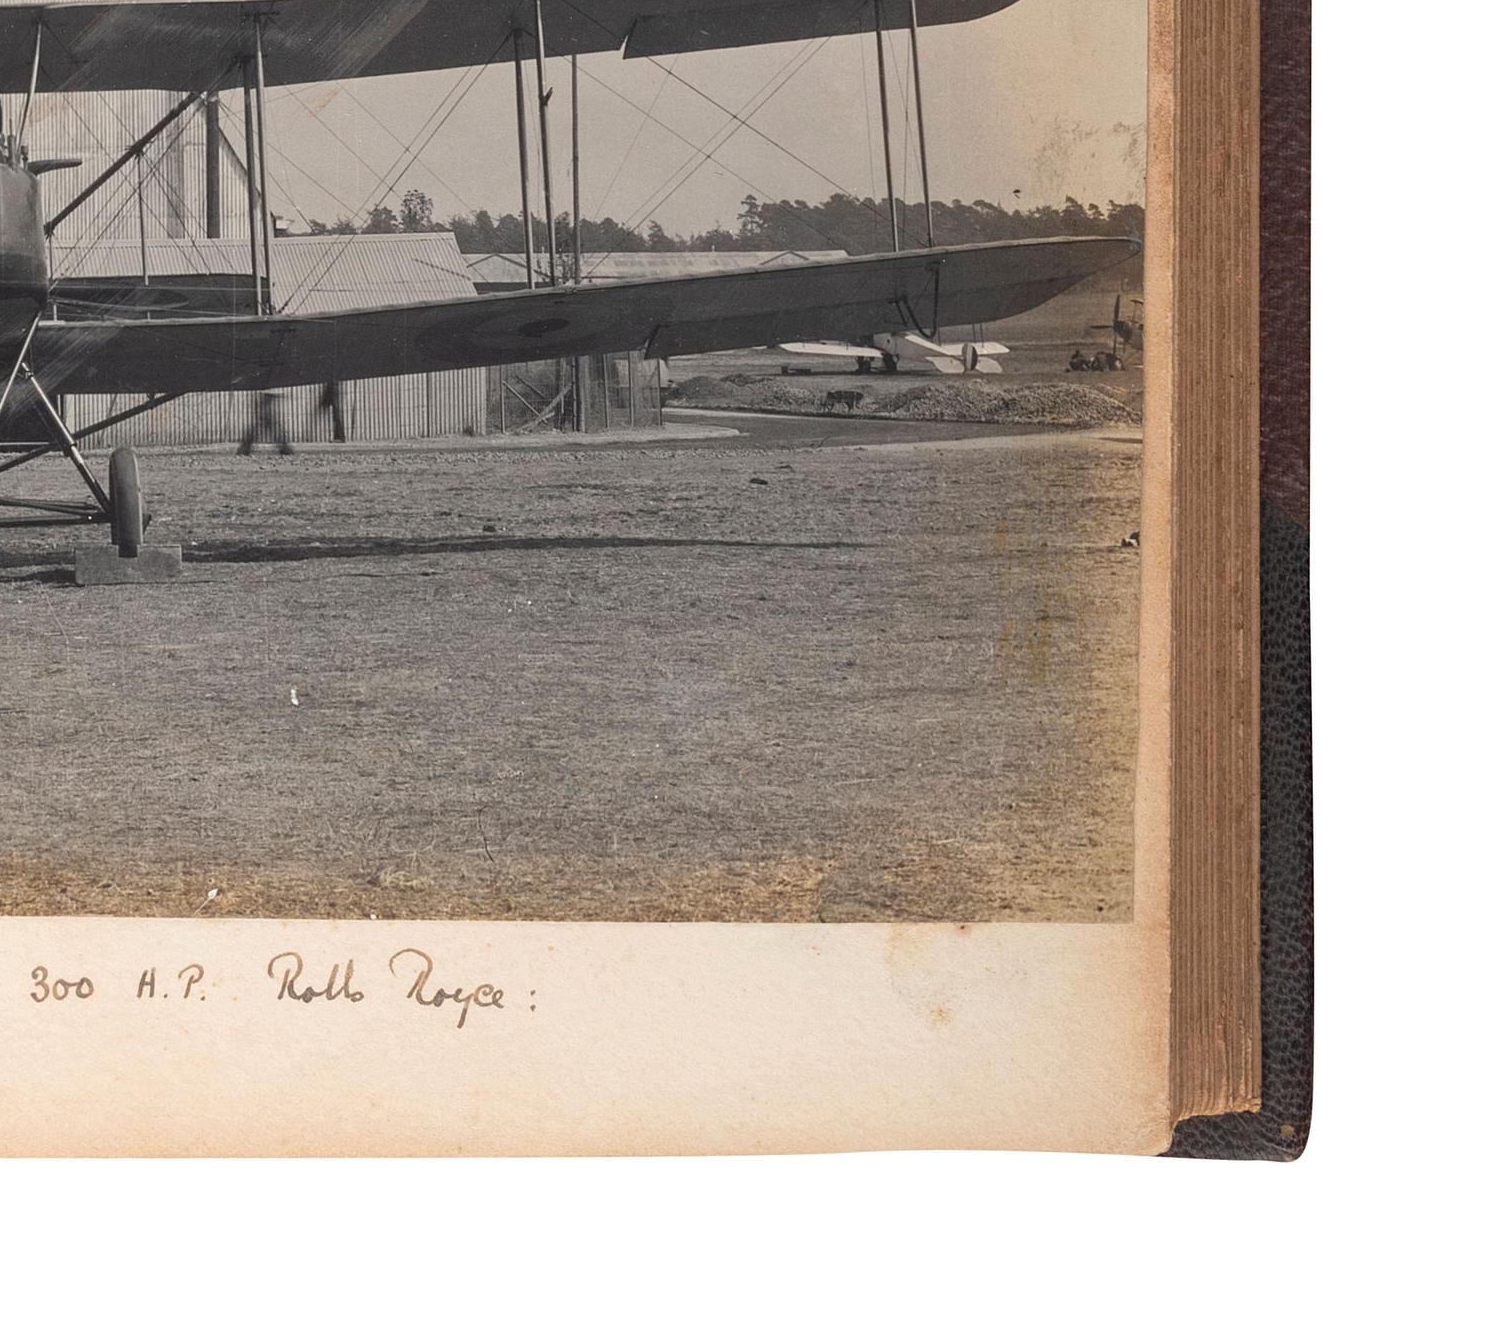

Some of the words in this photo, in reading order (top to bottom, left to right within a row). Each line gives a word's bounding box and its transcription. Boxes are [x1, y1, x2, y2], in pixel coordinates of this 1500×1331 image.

[29, 965, 95, 1004] 300
[136, 963, 206, 1002] H.P.
[267, 951, 365, 1004] Rolls
